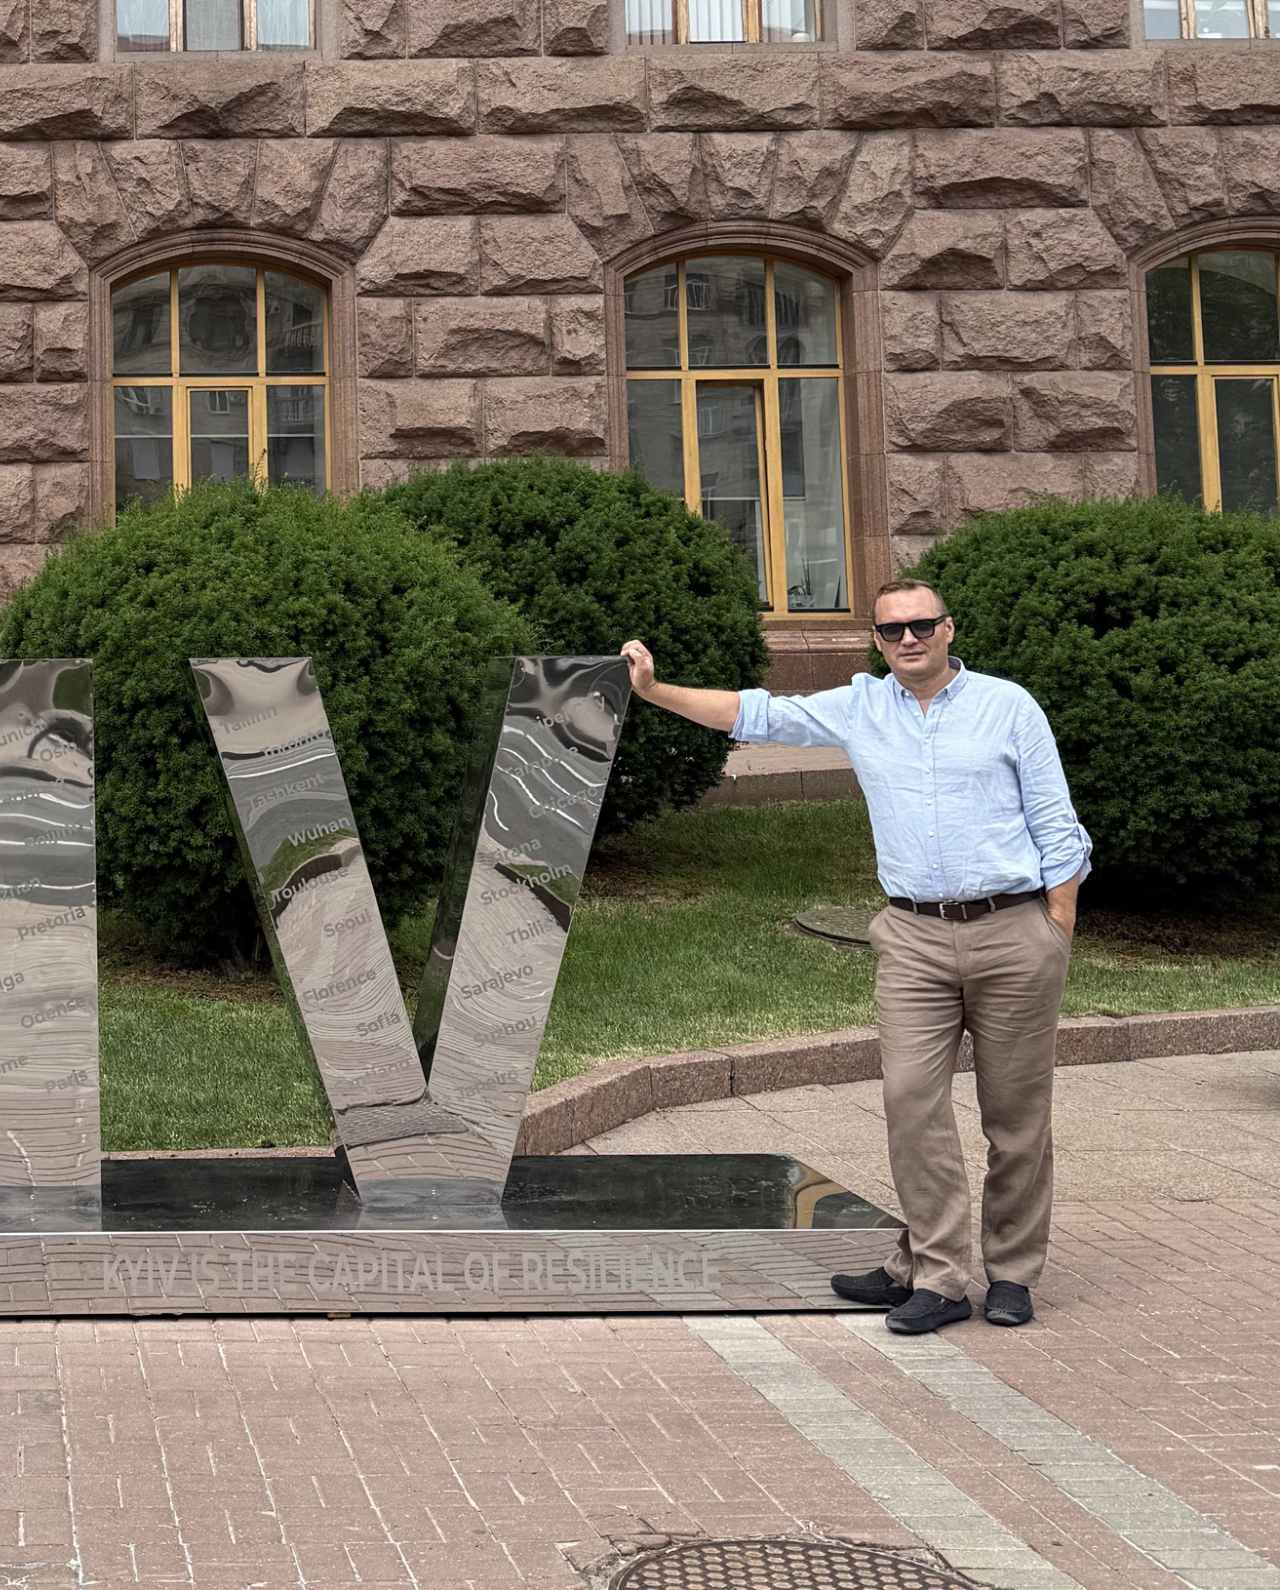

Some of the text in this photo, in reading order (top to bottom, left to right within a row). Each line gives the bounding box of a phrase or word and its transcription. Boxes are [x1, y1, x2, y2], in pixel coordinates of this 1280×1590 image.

[221, 706, 277, 734] Tallinn
[39, 741, 78, 763] Oslo
[262, 727, 330, 757] Toronto
[505, 745, 579, 779] Tampe
[249, 771, 324, 810] Tashkent
[288, 815, 350, 848] Wuhan
[493, 838, 542, 866] irana
[272, 867, 348, 903] Toulouse
[480, 862, 571, 906] Stockholm
[18, 906, 86, 941] Pretoria
[323, 908, 371, 938] Seoul
[506, 918, 556, 945] Tbilis
[302, 967, 377, 1004] Florence
[460, 963, 534, 1000] Sarajevo
[20, 996, 86, 1029] Odense
[355, 1011, 402, 1038] Sofia
[473, 1015, 538, 1047] Suzhou
[44, 1068, 88, 1095] Paris
[104, 1252, 182, 1293] KYIV
[192, 1253, 219, 1293] IS
[229, 1252, 297, 1293] THE
[308, 1251, 455, 1293] CAPITAL
[464, 1250, 511, 1291] OF
